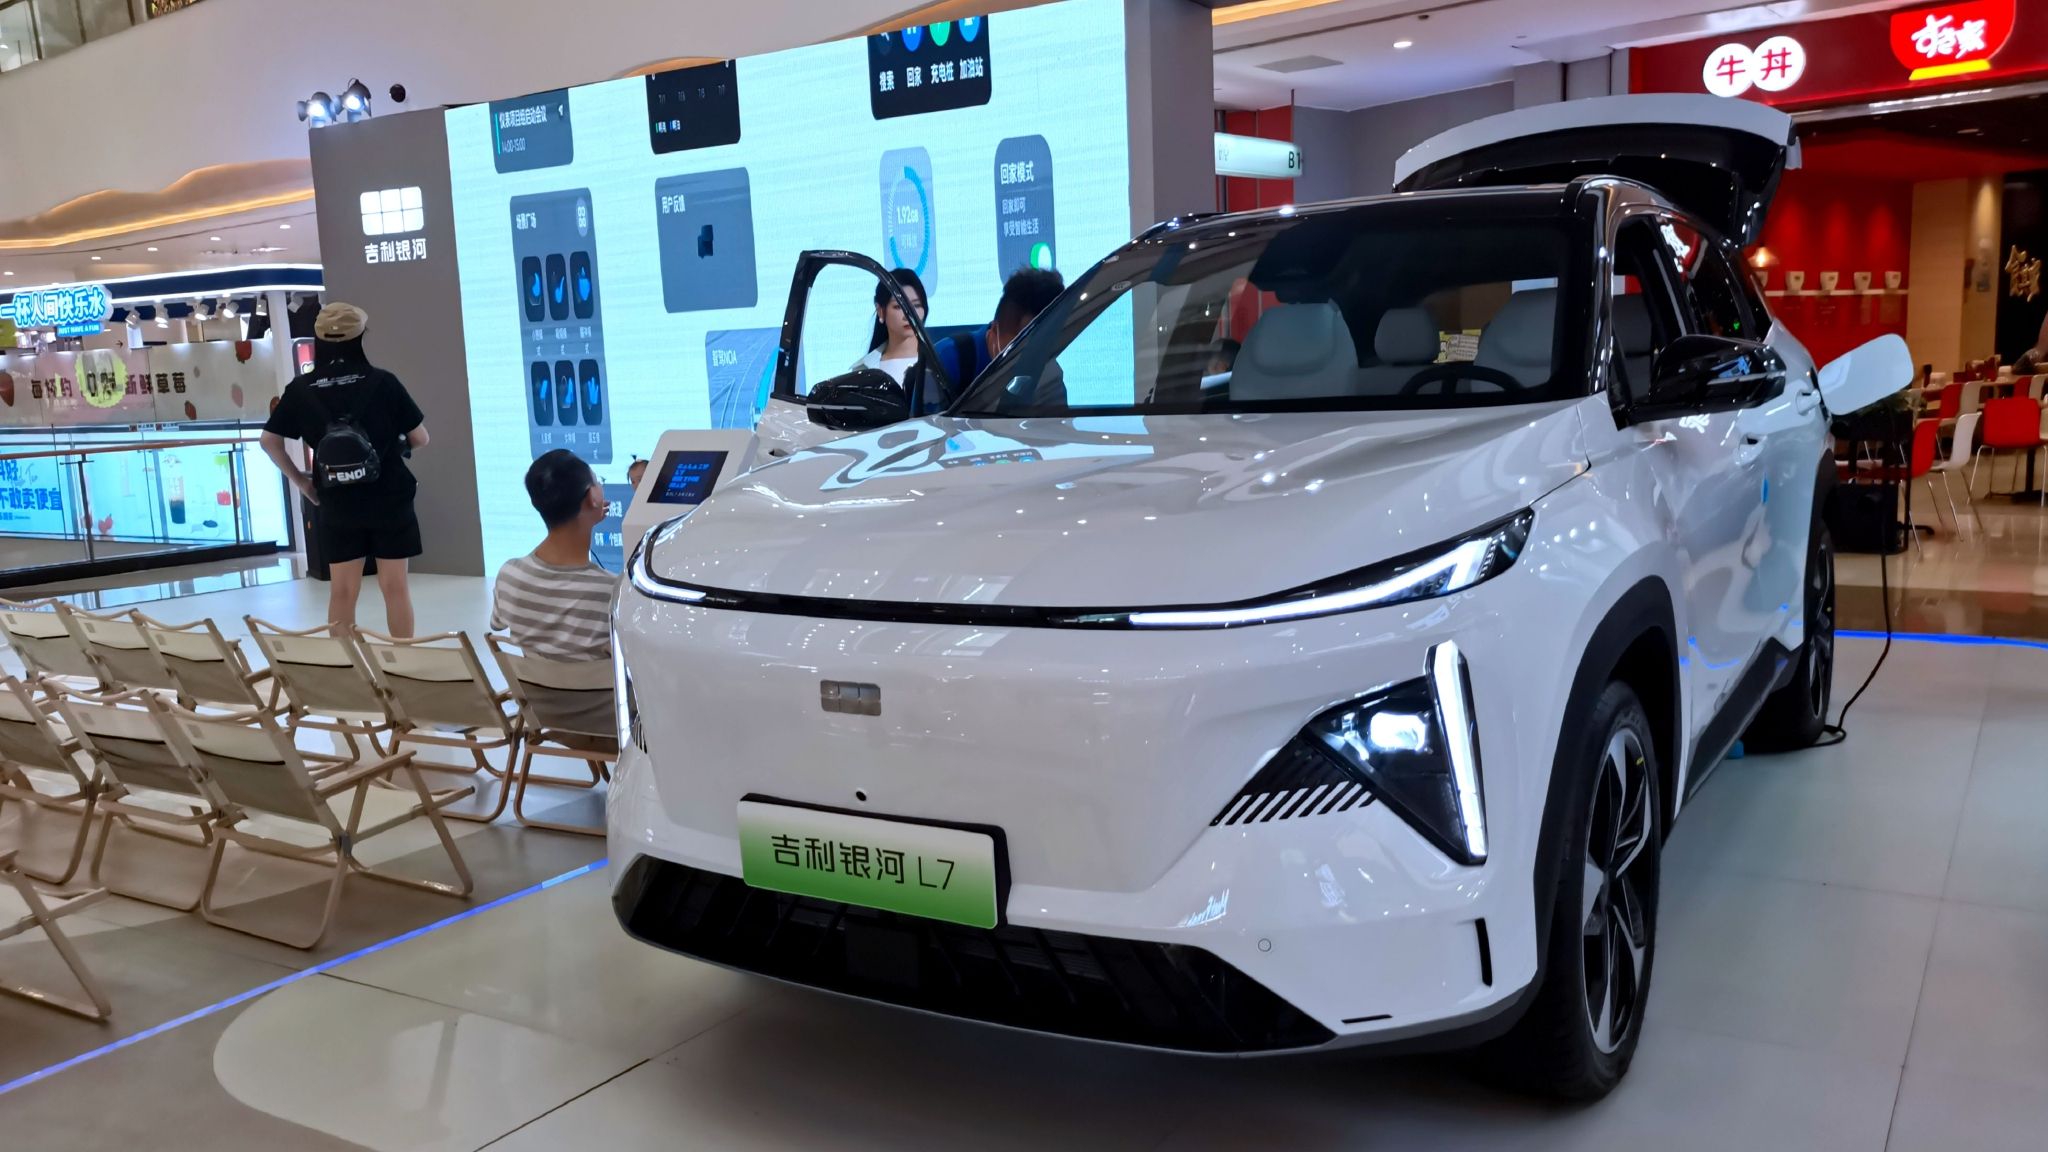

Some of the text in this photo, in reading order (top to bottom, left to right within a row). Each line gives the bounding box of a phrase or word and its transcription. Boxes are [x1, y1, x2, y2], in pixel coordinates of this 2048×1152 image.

[879, 56, 984, 92] 搜索 回家 充电桩 加油站
[1716, 46, 1793, 85] 牛丼
[1000, 160, 1035, 185] 回家模式
[1002, 196, 1027, 215] 回家即可
[1003, 218, 1040, 237] 享受智能生活
[364, 238, 428, 264] 吉利银河
[1, 287, 105, 326] 一杯人间快乐水
[328, 467, 366, 482] FENDI
[0, 487, 63, 511] 不敢卖便宜
[771, 834, 956, 891] 吉利银河 L7
